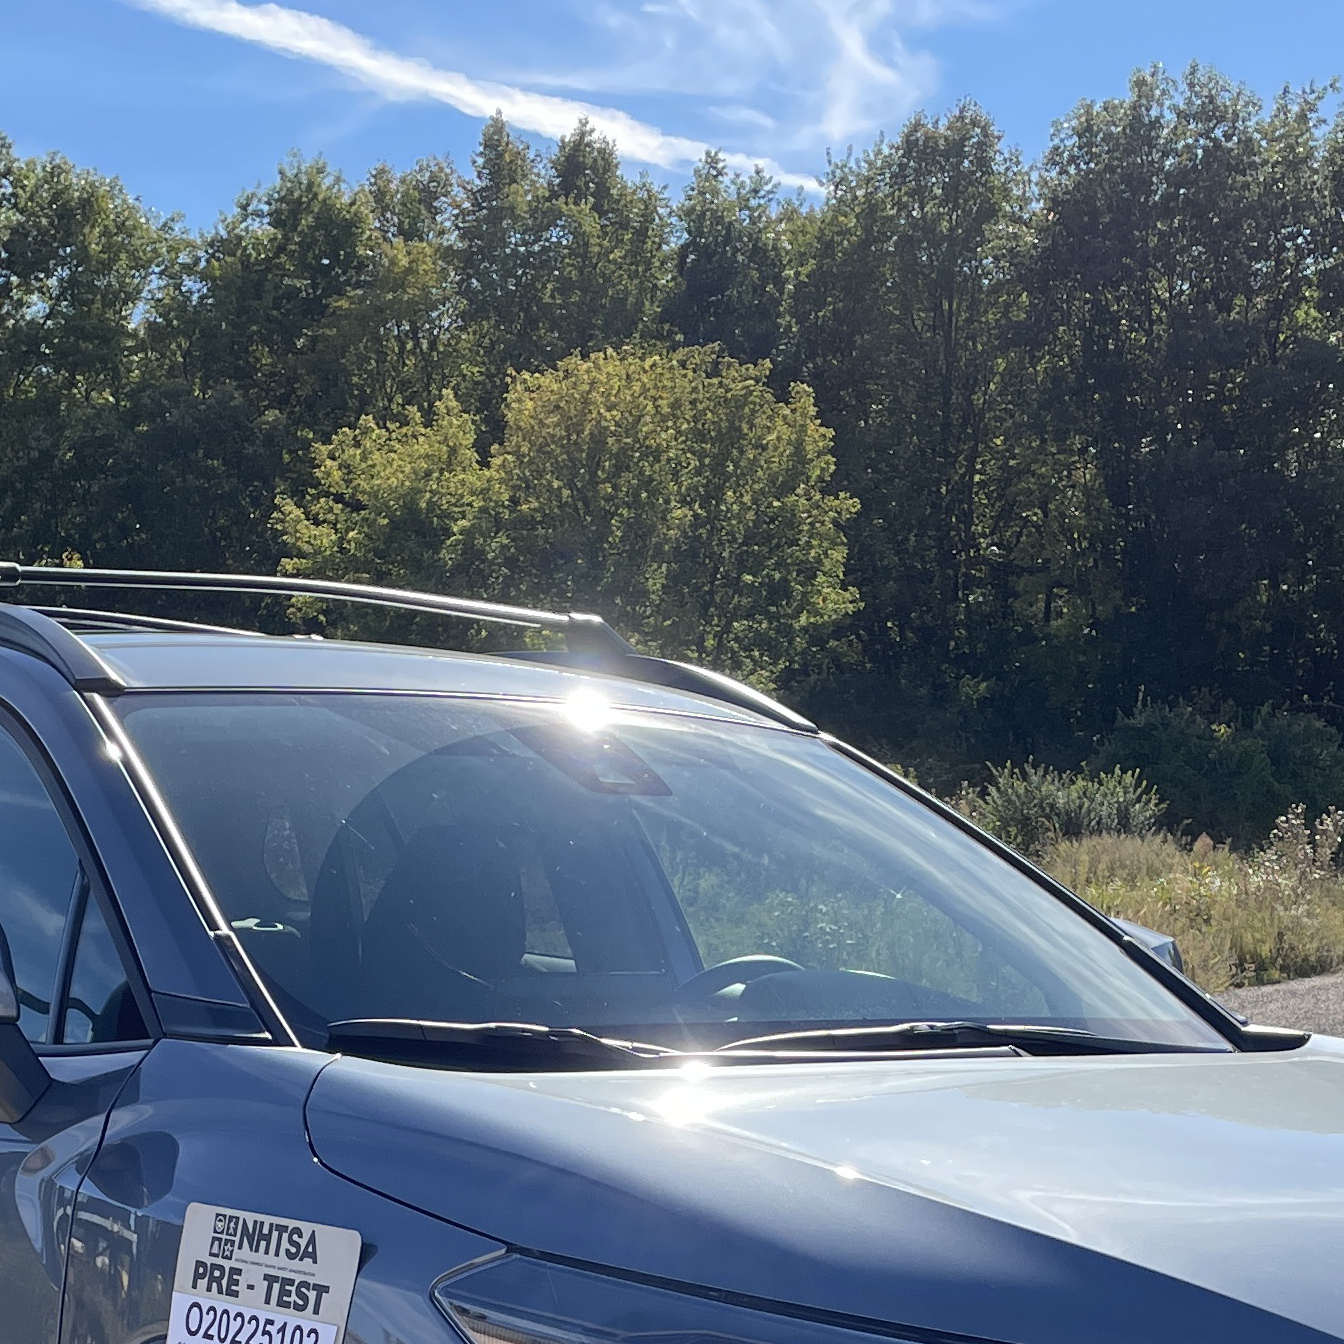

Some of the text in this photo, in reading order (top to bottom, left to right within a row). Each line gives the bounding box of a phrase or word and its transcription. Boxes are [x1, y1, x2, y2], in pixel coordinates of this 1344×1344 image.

[237, 1217, 318, 1264] NHTSA
[191, 1260, 243, 1299] PRE
[262, 1273, 330, 1315] TEST
